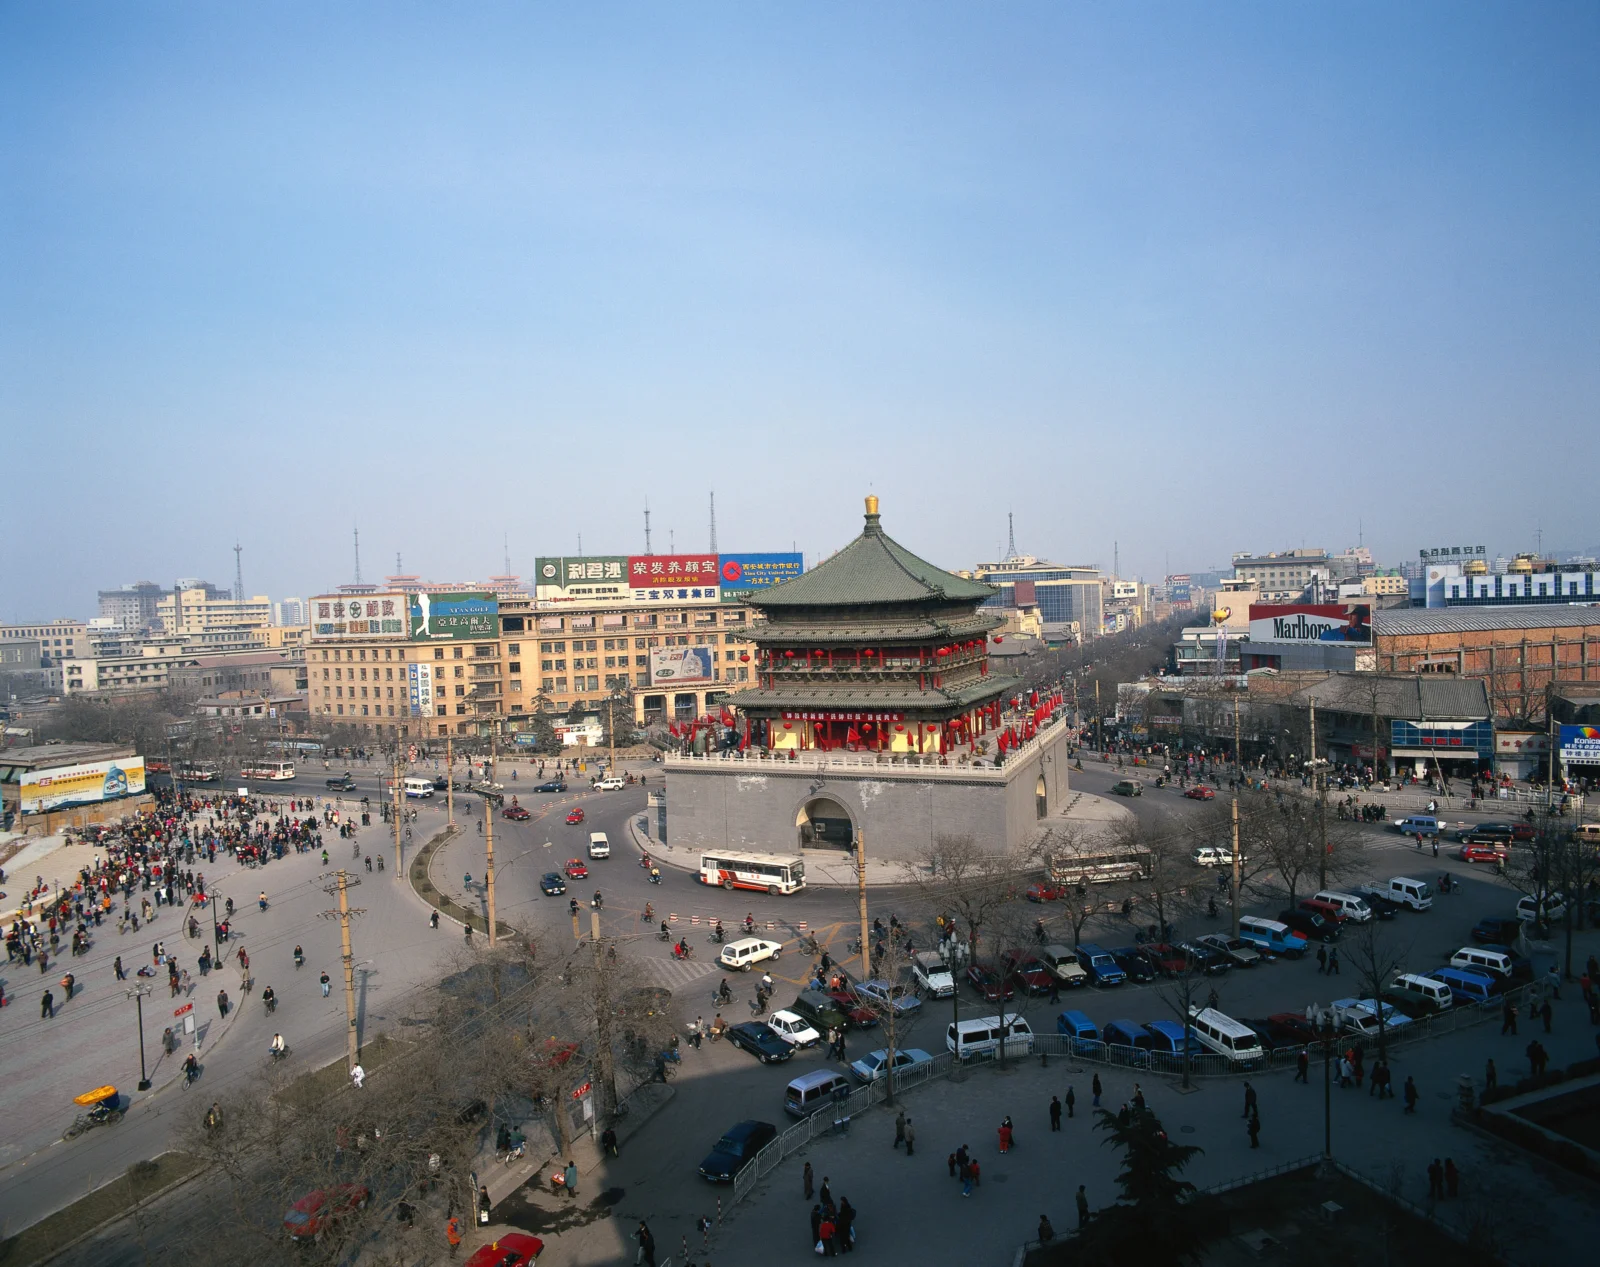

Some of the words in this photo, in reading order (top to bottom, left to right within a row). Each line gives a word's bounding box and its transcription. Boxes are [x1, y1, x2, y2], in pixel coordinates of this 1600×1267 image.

[568, 562, 621, 579] 利君沙
[633, 560, 716, 574] 荣发养颜宝
[635, 589, 715, 600] 三宝双喜集团
[318, 602, 345, 618] 西安
[366, 600, 395, 617] 邮政
[438, 616, 490, 626] 亞建高爾夫
